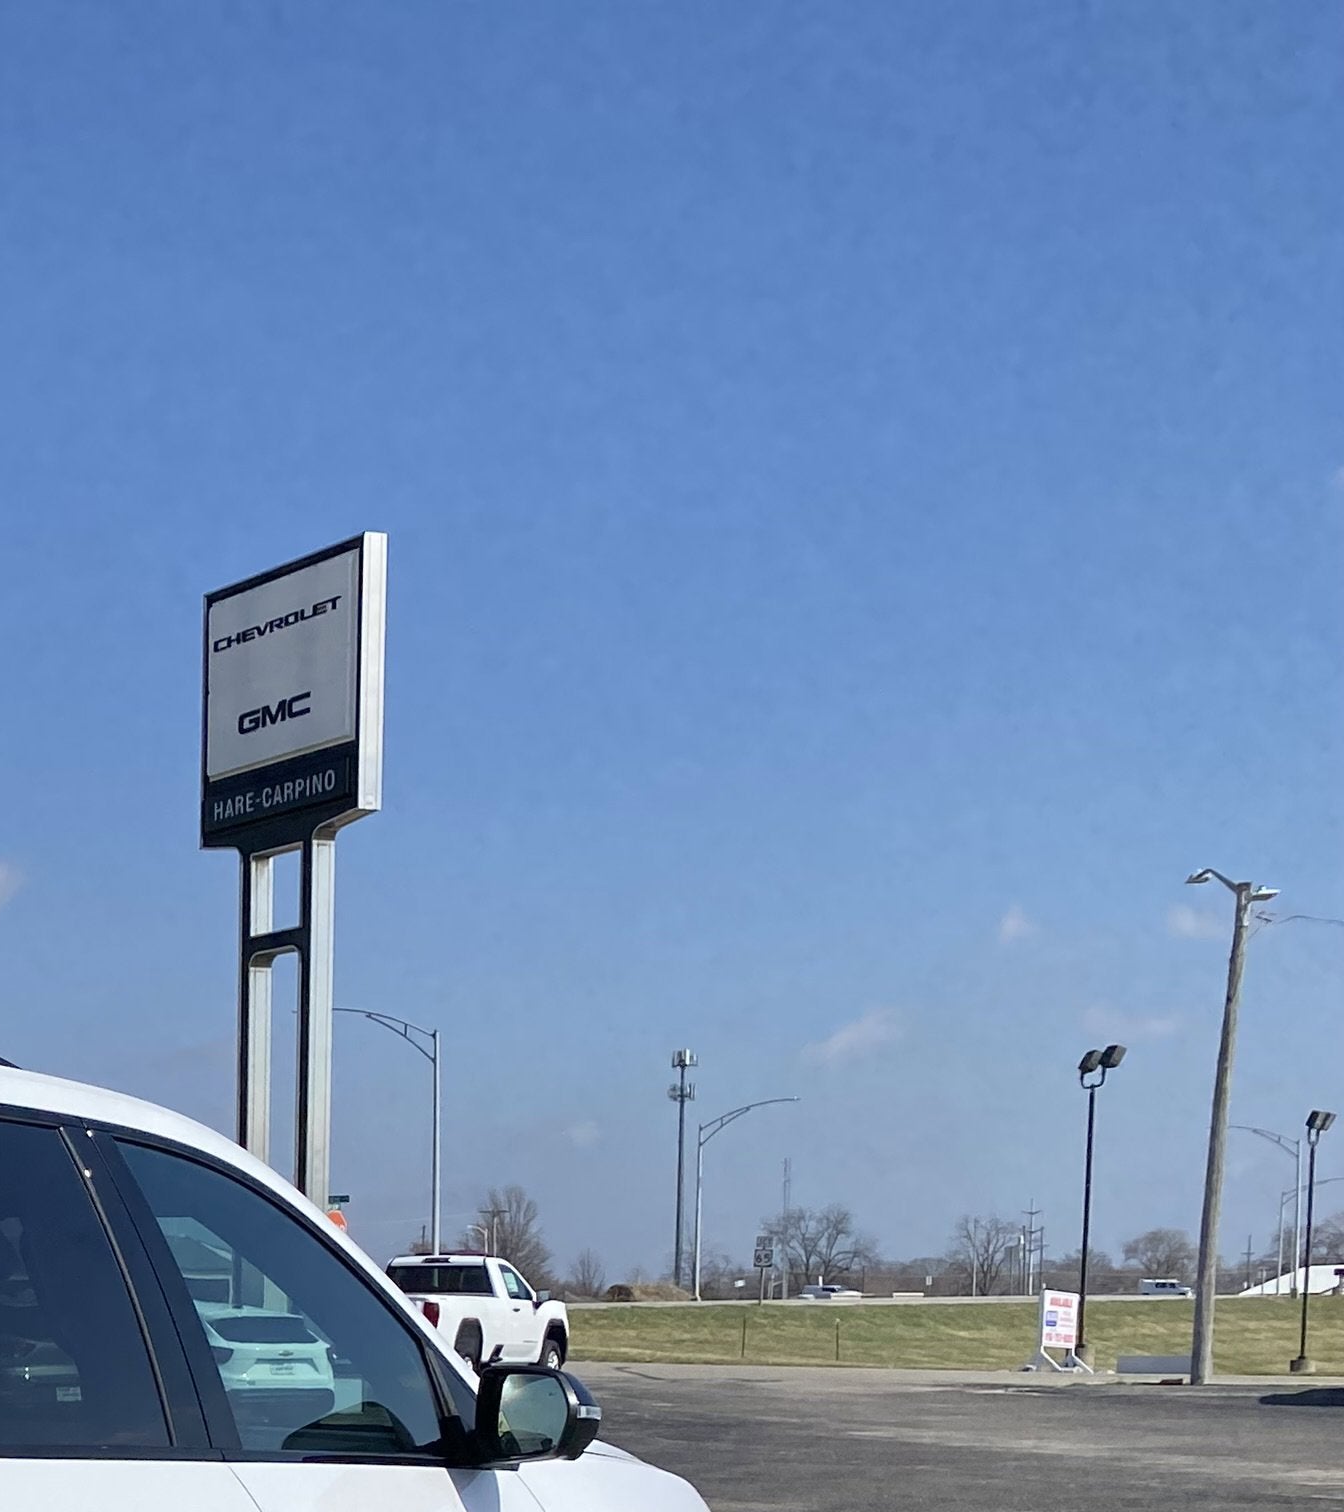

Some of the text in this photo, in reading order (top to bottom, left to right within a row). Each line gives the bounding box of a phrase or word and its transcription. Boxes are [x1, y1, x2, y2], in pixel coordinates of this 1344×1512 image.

[213, 595, 343, 653] CHEVROLET
[237, 691, 311, 735] GMC
[214, 769, 336, 822] HARE-CARPINO
